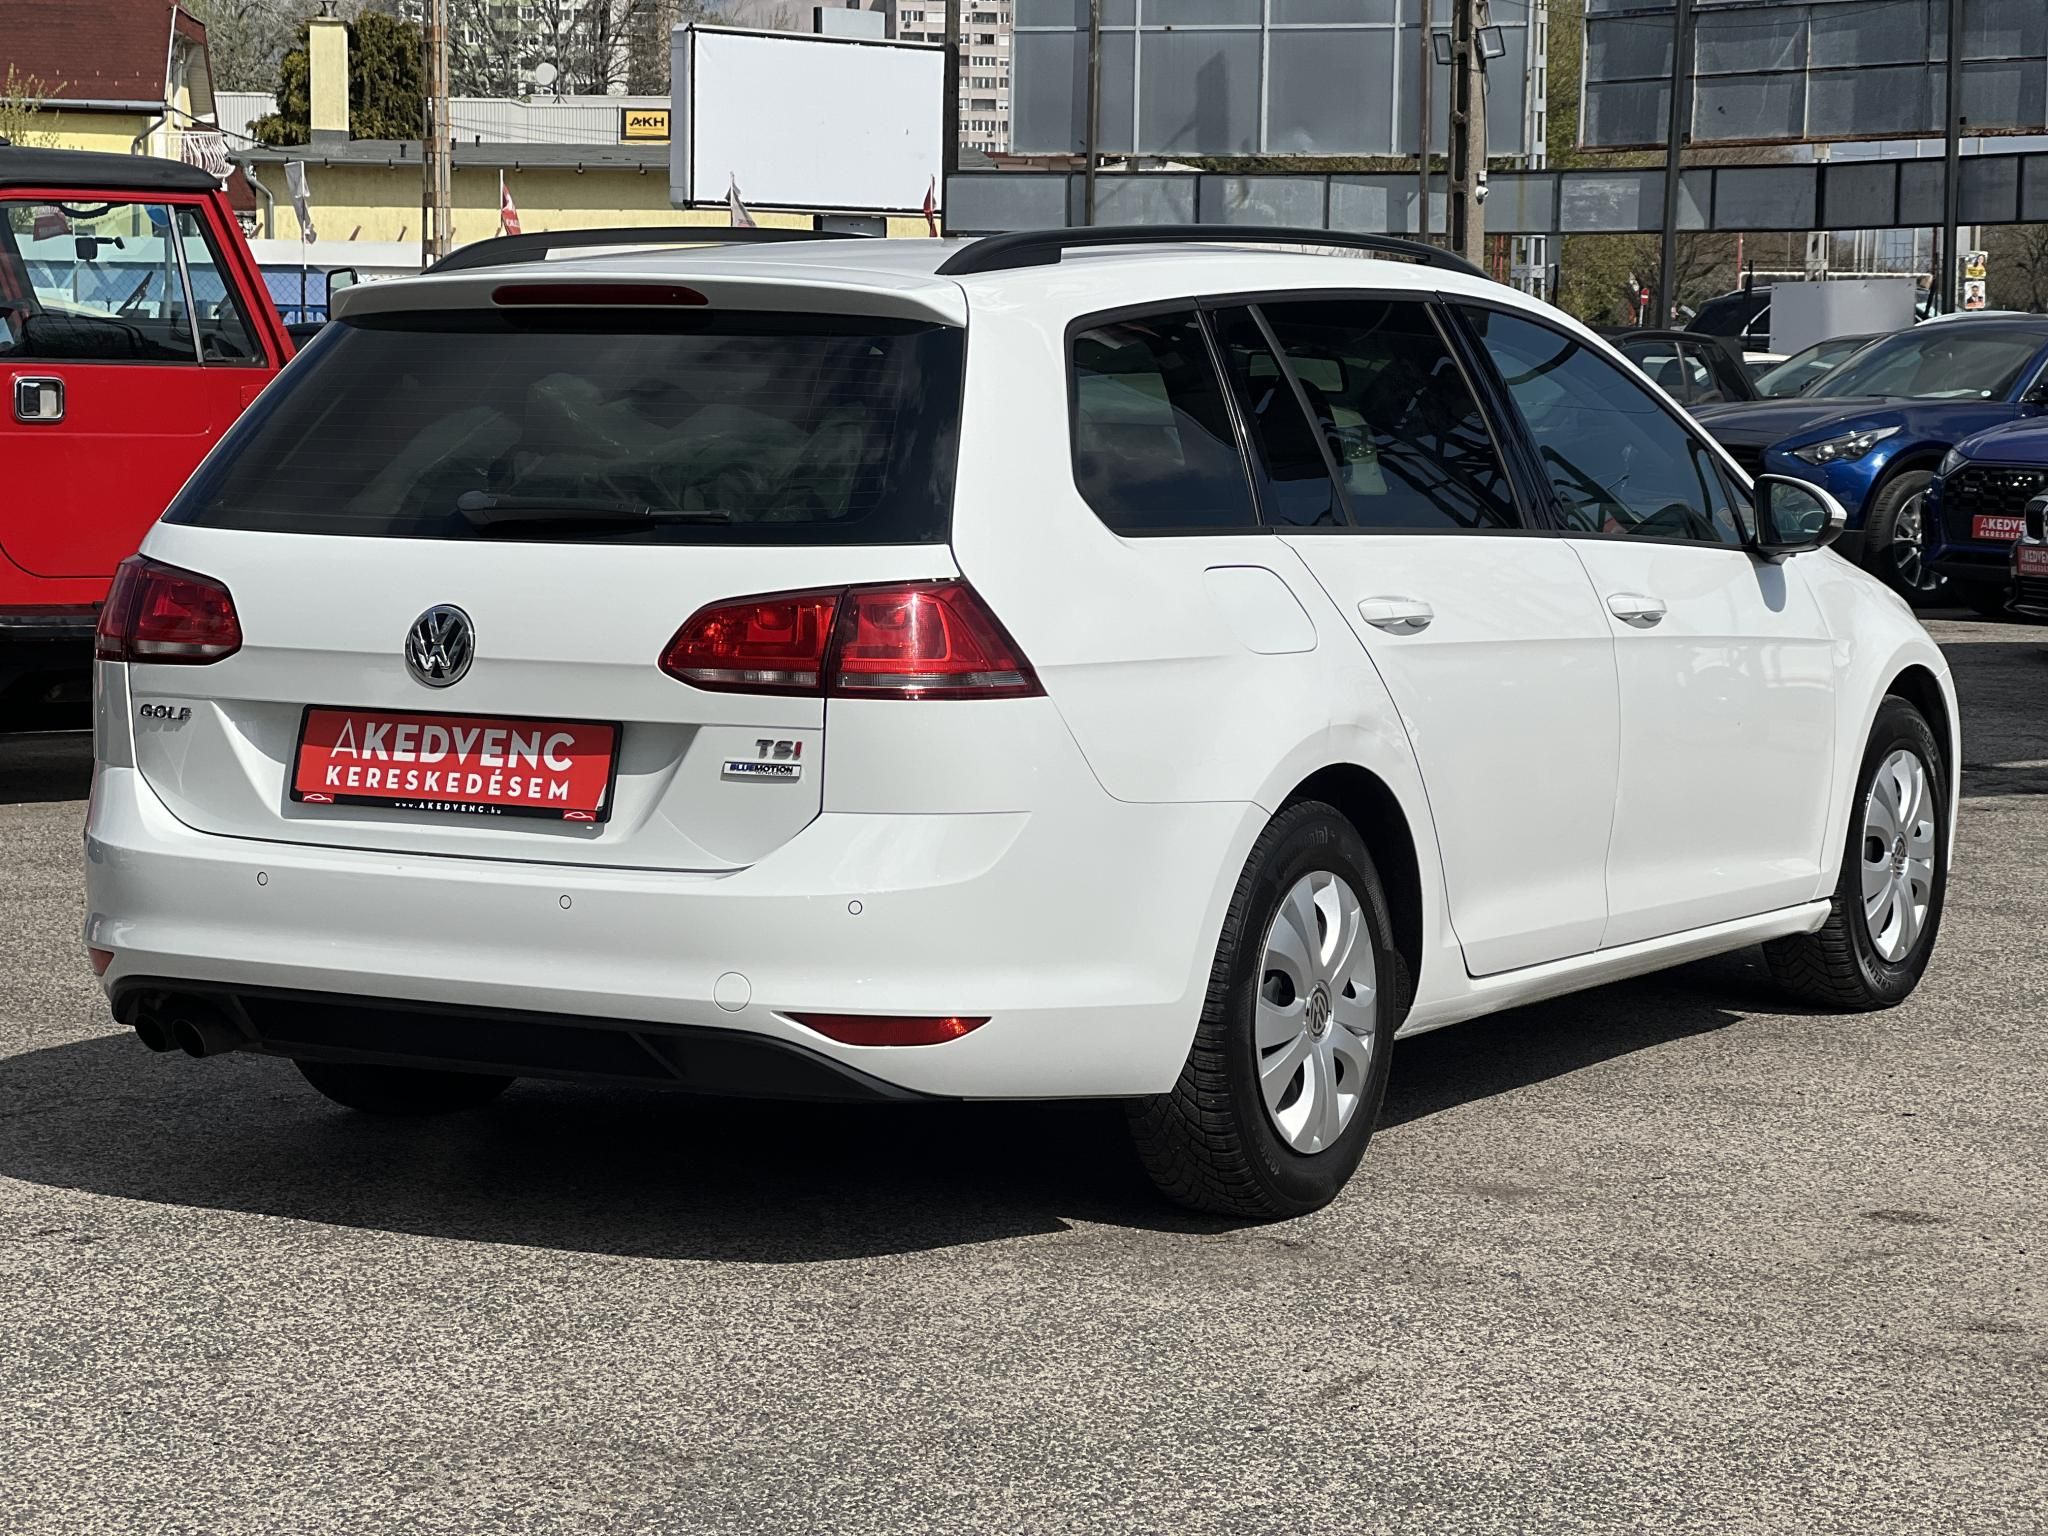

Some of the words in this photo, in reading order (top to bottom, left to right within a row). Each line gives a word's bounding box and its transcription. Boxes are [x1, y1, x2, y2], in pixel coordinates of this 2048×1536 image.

[629, 117, 664, 127] AKH
[140, 703, 192, 720] GOLF
[330, 718, 575, 772] AKEDVENC
[755, 739, 802, 760] TSI
[730, 763, 793, 773] BLUEMOTION
[325, 766, 569, 800] KERESKEDÉSEM
[395, 802, 501, 814] www.AKEDVENC.hu
